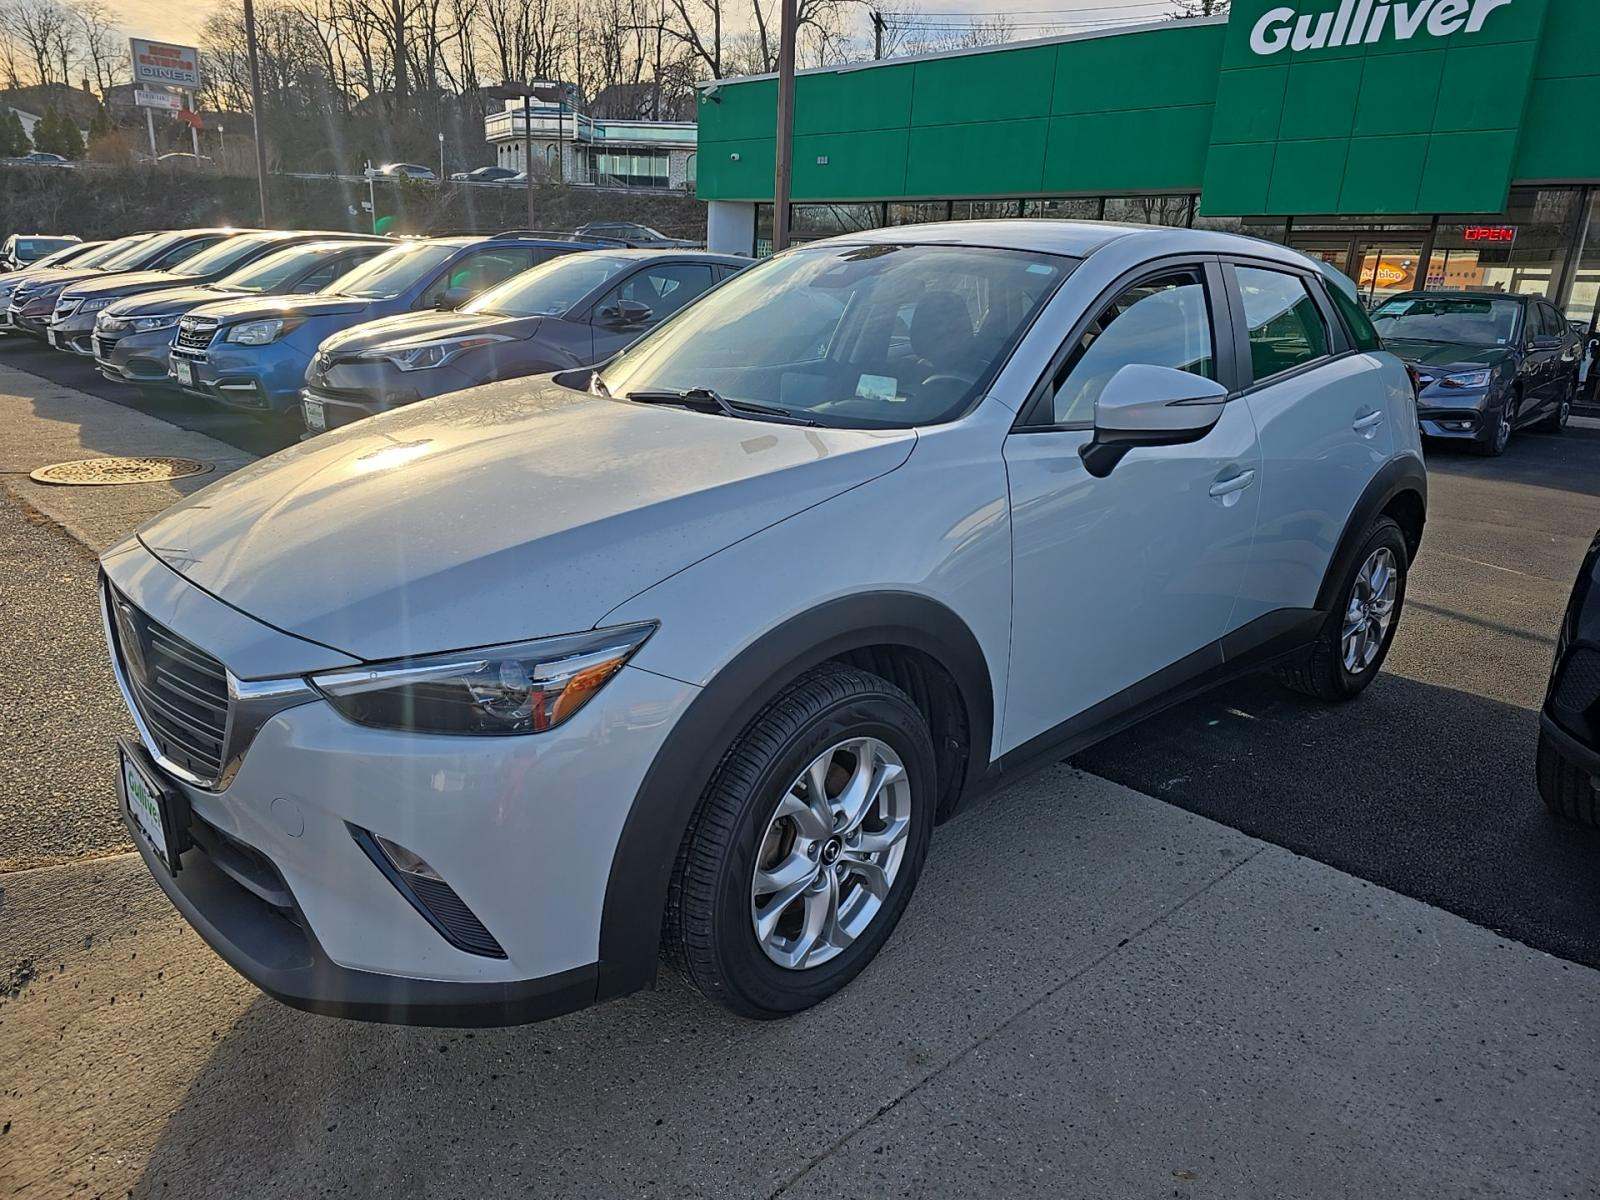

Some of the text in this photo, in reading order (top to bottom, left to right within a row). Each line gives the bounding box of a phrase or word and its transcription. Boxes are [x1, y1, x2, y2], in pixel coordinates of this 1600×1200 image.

[1249, 0, 1512, 55] Gulliver
[142, 66, 195, 82] DINER
[1465, 229, 1513, 241] OPEN
